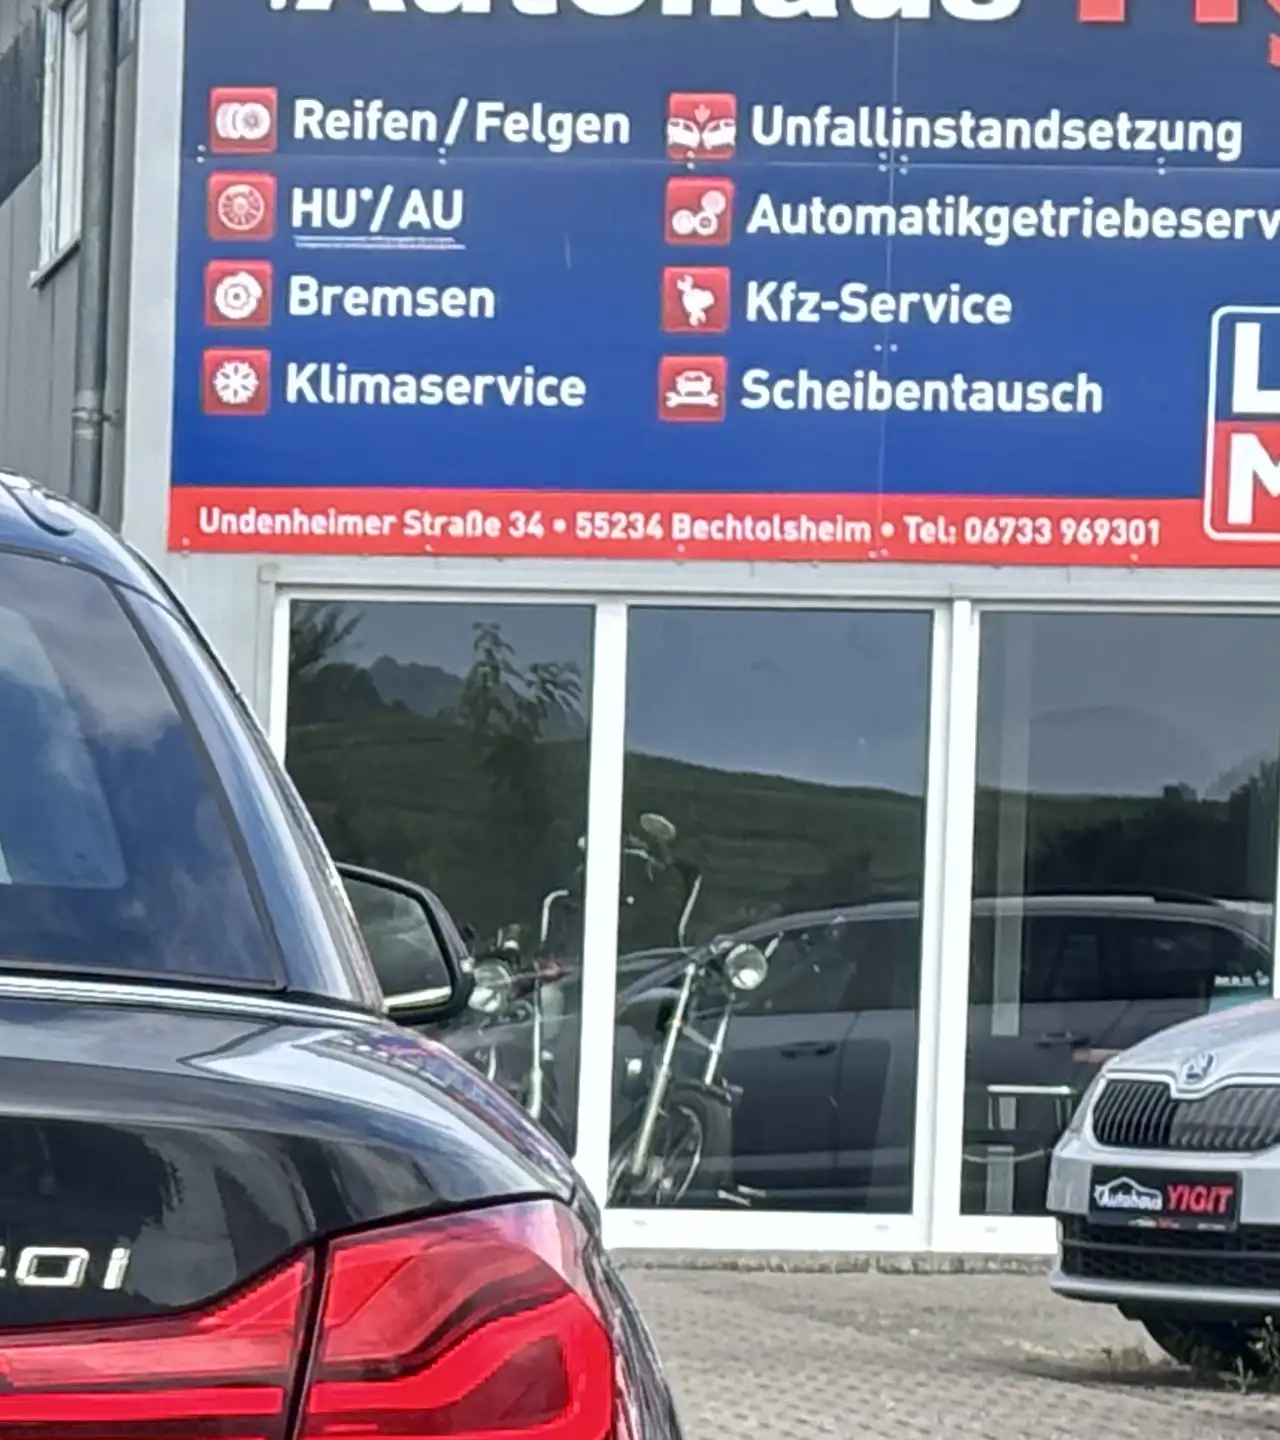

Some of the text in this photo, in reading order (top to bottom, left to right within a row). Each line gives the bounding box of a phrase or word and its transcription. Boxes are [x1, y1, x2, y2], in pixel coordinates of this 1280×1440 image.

[750, 105, 1243, 162] Unfallinstandsetzung
[745, 193, 1280, 246] Automatikgetriebeserv
[288, 275, 496, 319] Bremsen
[745, 280, 1014, 325] Kfz-Service
[285, 363, 587, 407] Klimaservice
[740, 368, 1105, 414] Scheibentausch
[199, 507, 1161, 547] Undenheimer Straße 34 55234 Bechtolsheim Tel: 06733 969301
[1167, 1184, 1233, 1214] YIGIT
